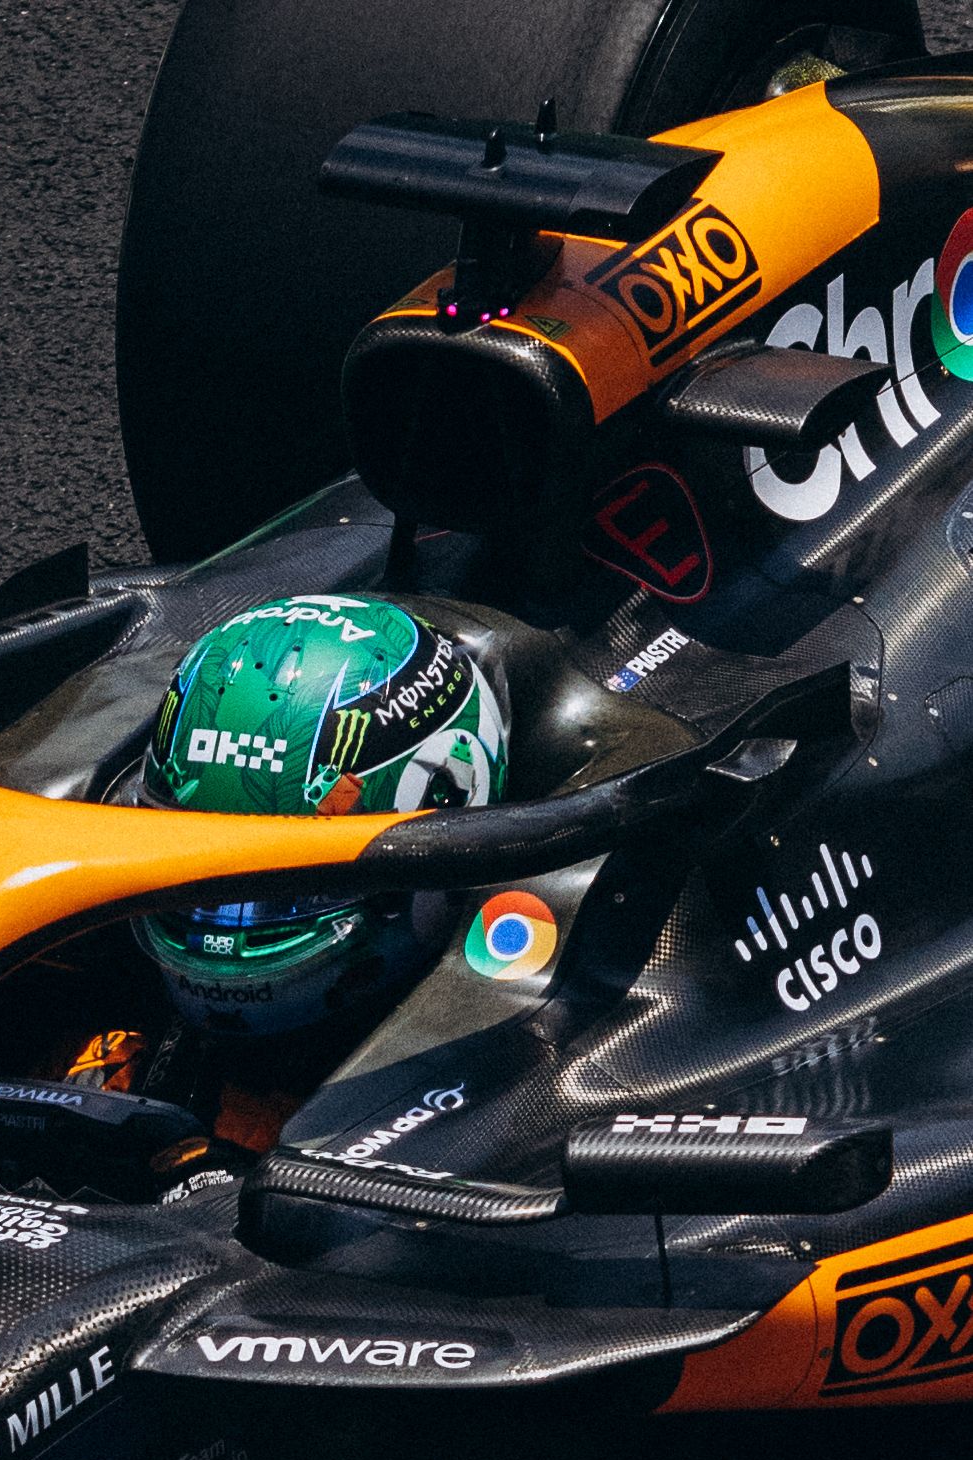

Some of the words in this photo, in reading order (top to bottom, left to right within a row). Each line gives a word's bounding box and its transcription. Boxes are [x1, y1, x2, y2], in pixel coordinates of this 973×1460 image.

[618, 217, 747, 335] OXXO
[221, 606, 376, 643] Android
[629, 628, 692, 679] PIASTRI
[187, 728, 288, 773] OKX
[203, 934, 234, 946] QUAD
[203, 944, 234, 956] LOCK
[775, 913, 883, 1012] CISCO
[178, 975, 274, 1003] Android
[196, 1335, 477, 1369] vmware
[7, 1345, 116, 1449] MILLE
